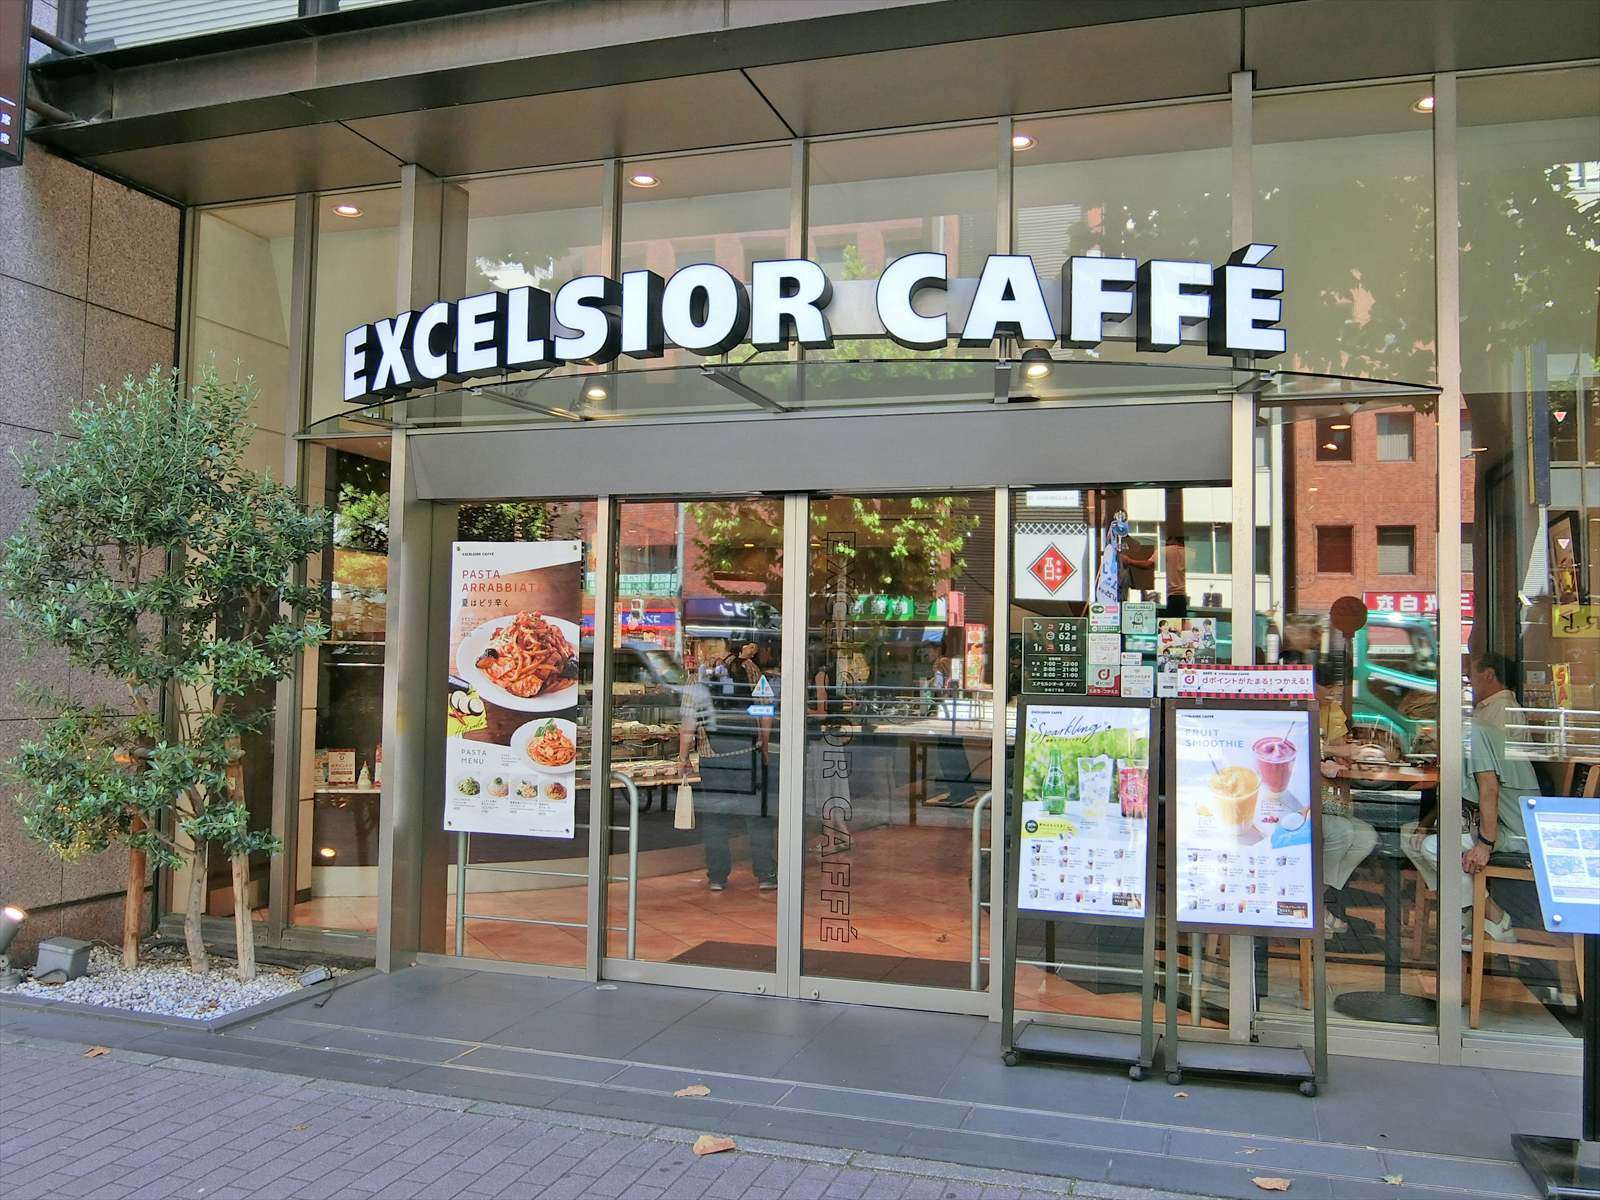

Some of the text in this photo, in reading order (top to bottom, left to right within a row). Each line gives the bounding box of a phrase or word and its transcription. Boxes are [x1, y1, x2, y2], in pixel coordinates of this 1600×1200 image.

[344, 243, 1287, 402] EXCELSIOR CAFFÉ
[462, 570, 501, 579] PASTA
[461, 582, 545, 593] ARRABBIATA
[461, 598, 509, 608] 夏はピリ辛く
[1030, 715, 1101, 744] Sparkling
[1185, 729, 1220, 737] FRUIT
[1185, 739, 1244, 748] SMOOTHIE
[461, 748, 487, 756] PASTA
[461, 757, 484, 765] MENU
